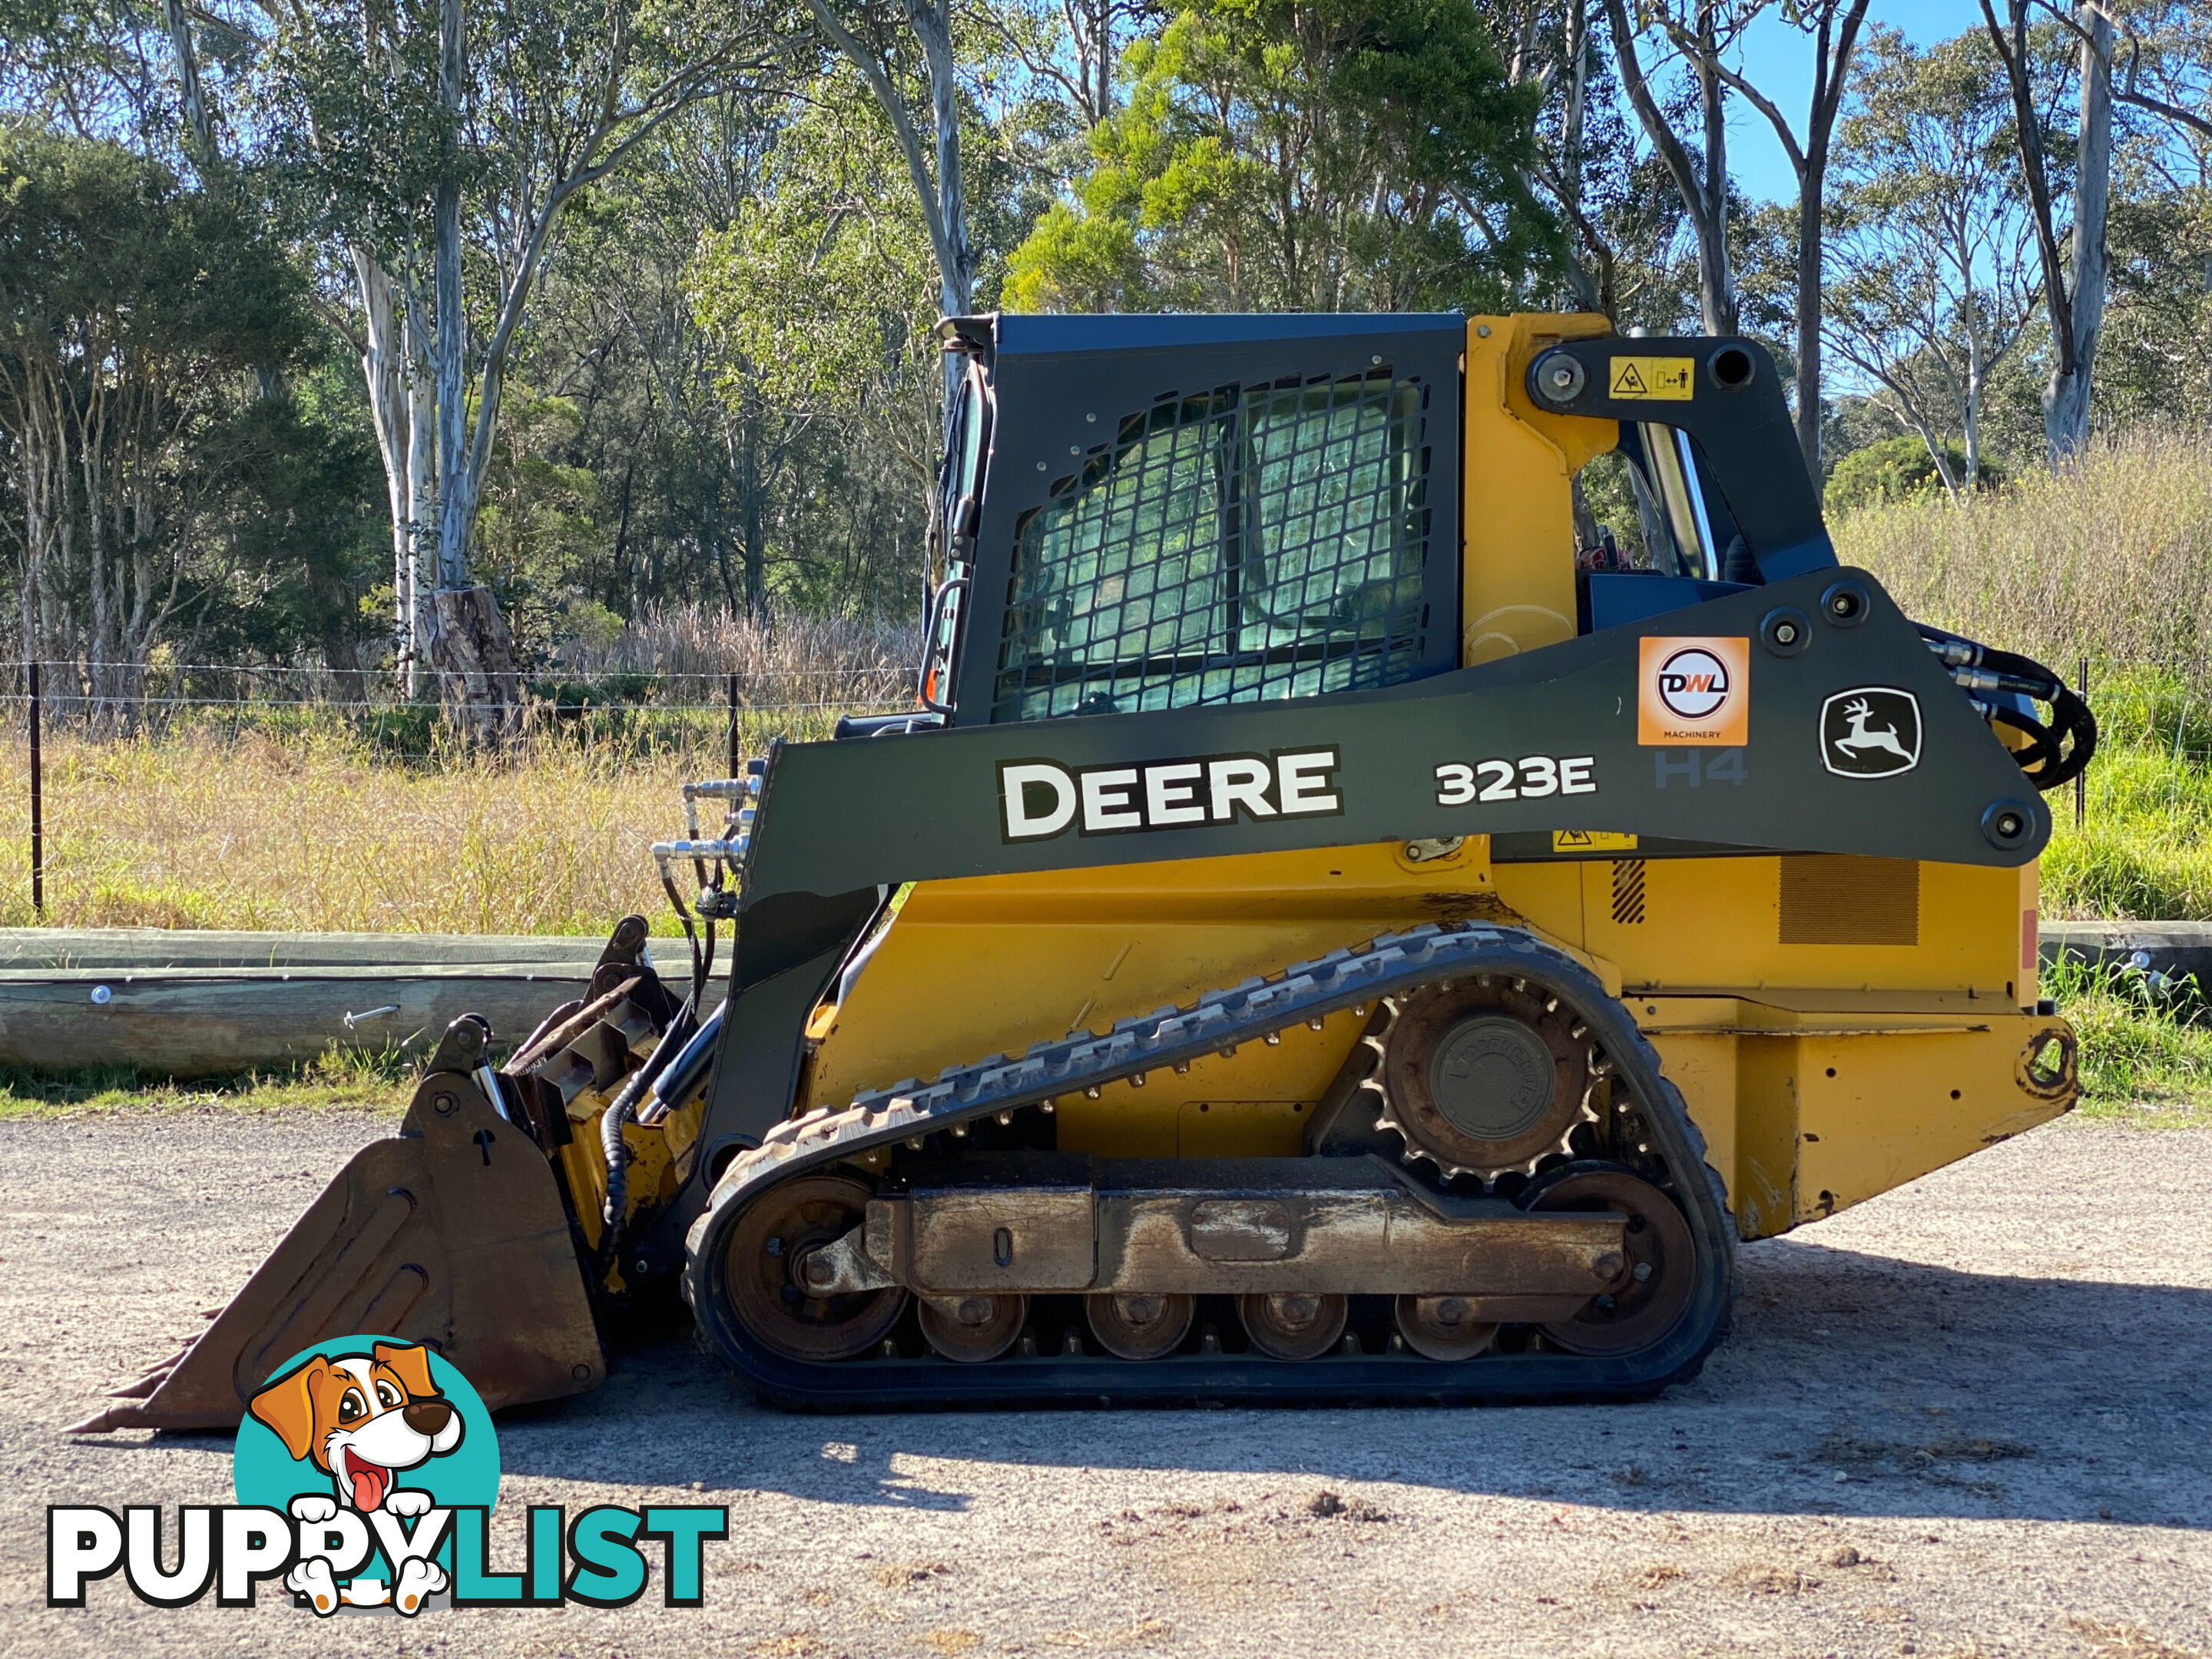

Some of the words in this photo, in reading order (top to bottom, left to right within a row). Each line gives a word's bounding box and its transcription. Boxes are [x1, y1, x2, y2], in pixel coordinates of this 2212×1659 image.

[1658, 674, 1728, 693] DWL
[1435, 756, 1596, 805] 323E
[1654, 747, 1749, 789] H4
[1003, 751, 1337, 837] DEERE
